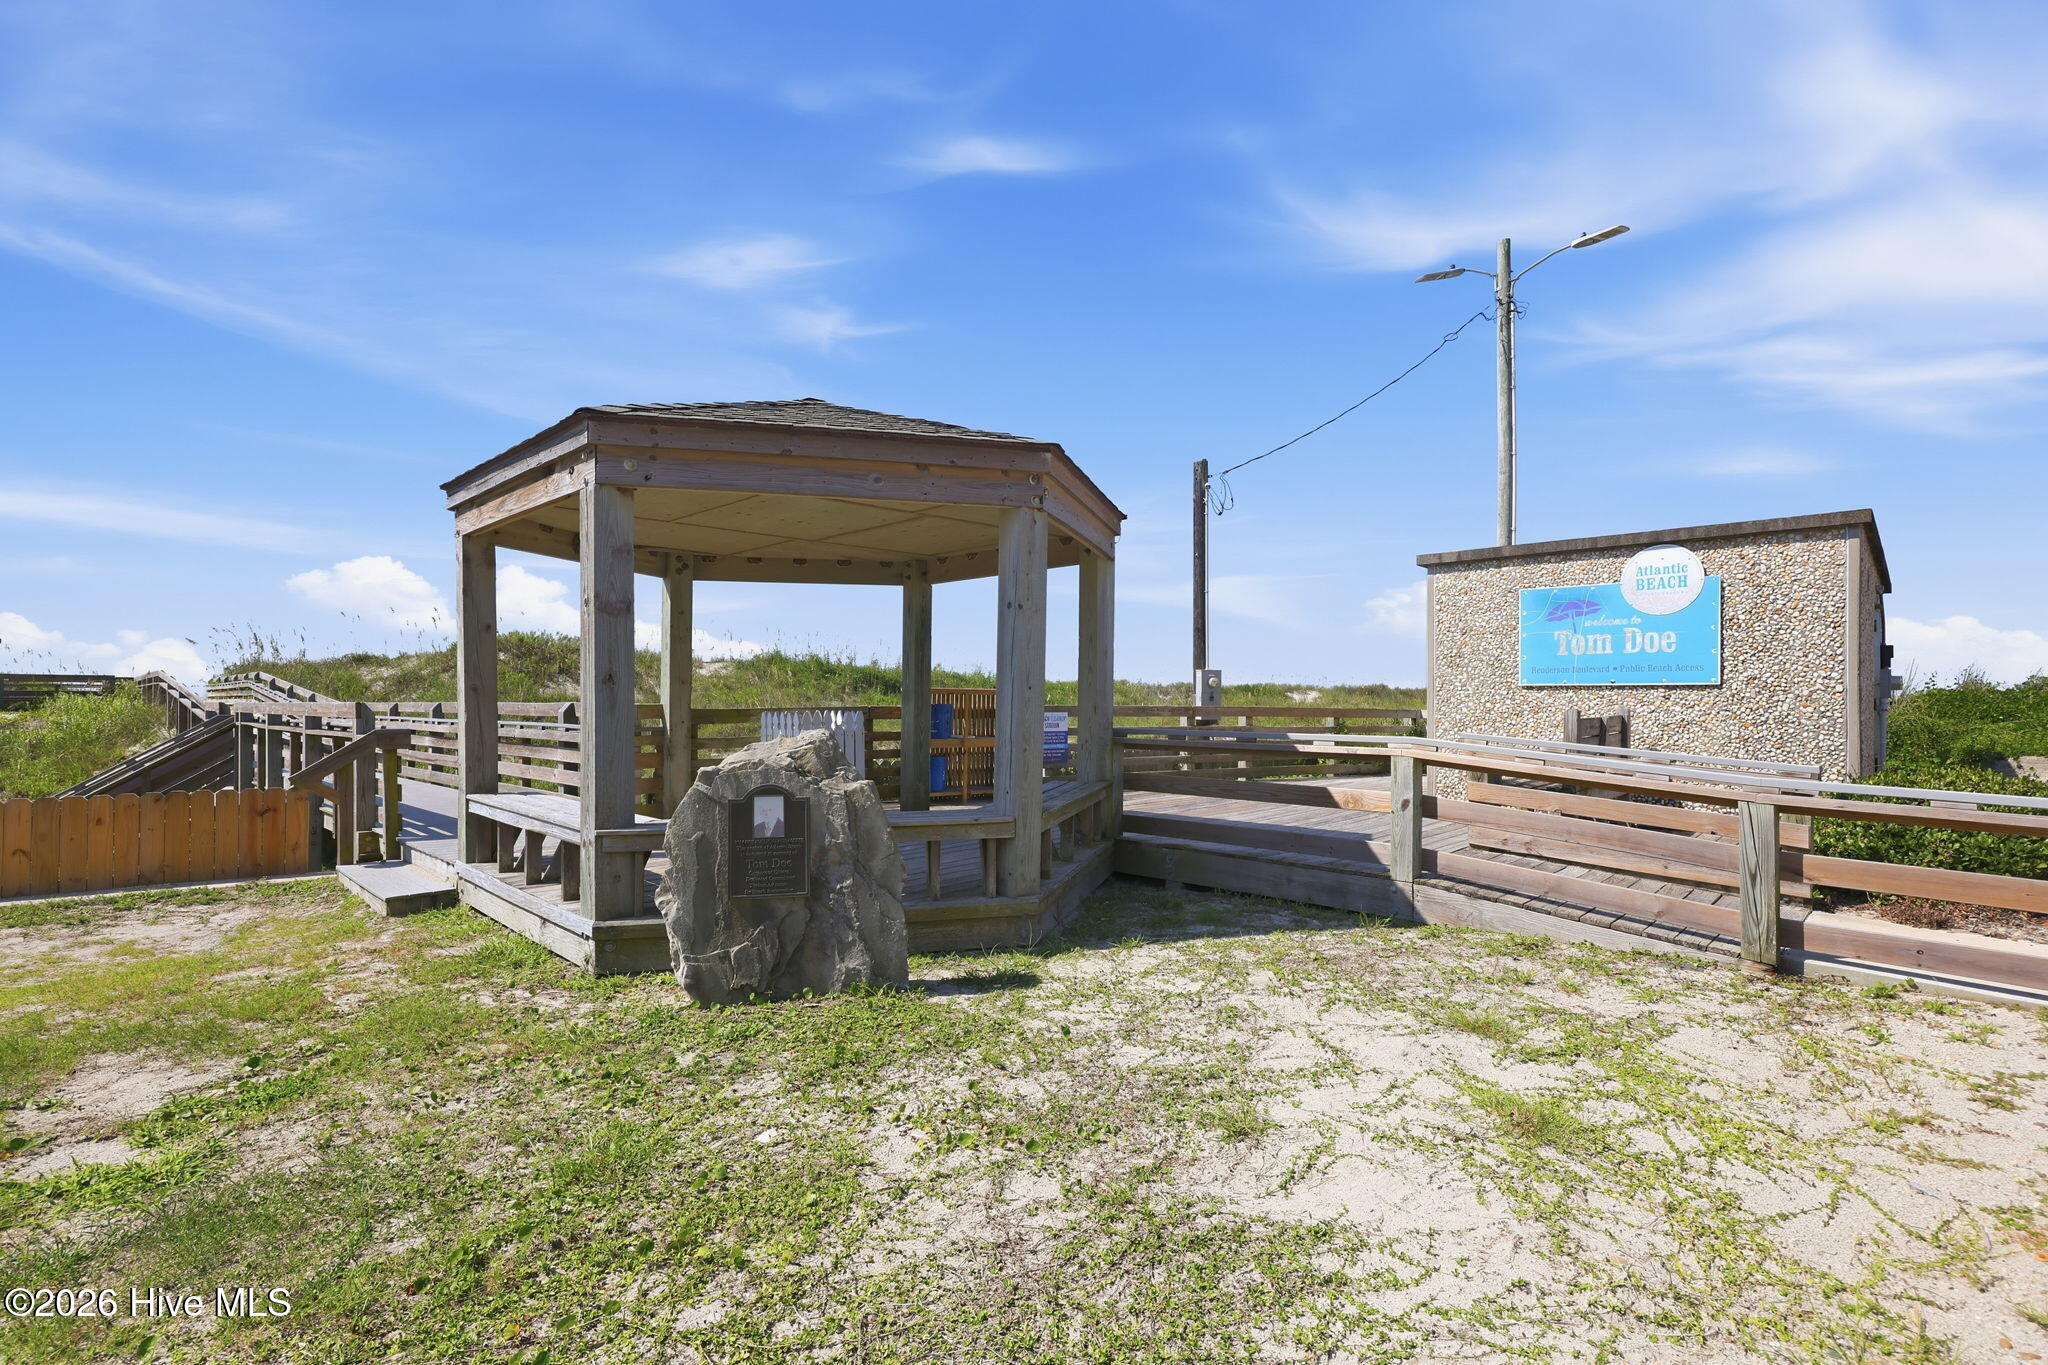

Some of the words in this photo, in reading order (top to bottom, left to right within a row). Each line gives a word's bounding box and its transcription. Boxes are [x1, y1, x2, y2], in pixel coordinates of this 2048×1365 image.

[1636, 563, 1689, 577] Atlantic
[1636, 575, 1689, 591] BEACH
[1584, 614, 1629, 627] welcome
[1630, 615, 1642, 625] to
[1553, 630, 1614, 656] Tom
[1623, 627, 1678, 654] Doe
[1531, 666, 1570, 674] Henderson
[1572, 665, 1610, 673] Boulevard
[1619, 664, 1646, 673] Public
[1647, 663, 1673, 673] Beach
[1674, 663, 1705, 672] Access
[745, 858, 768, 869] Tom
[771, 858, 792, 868] Doe
